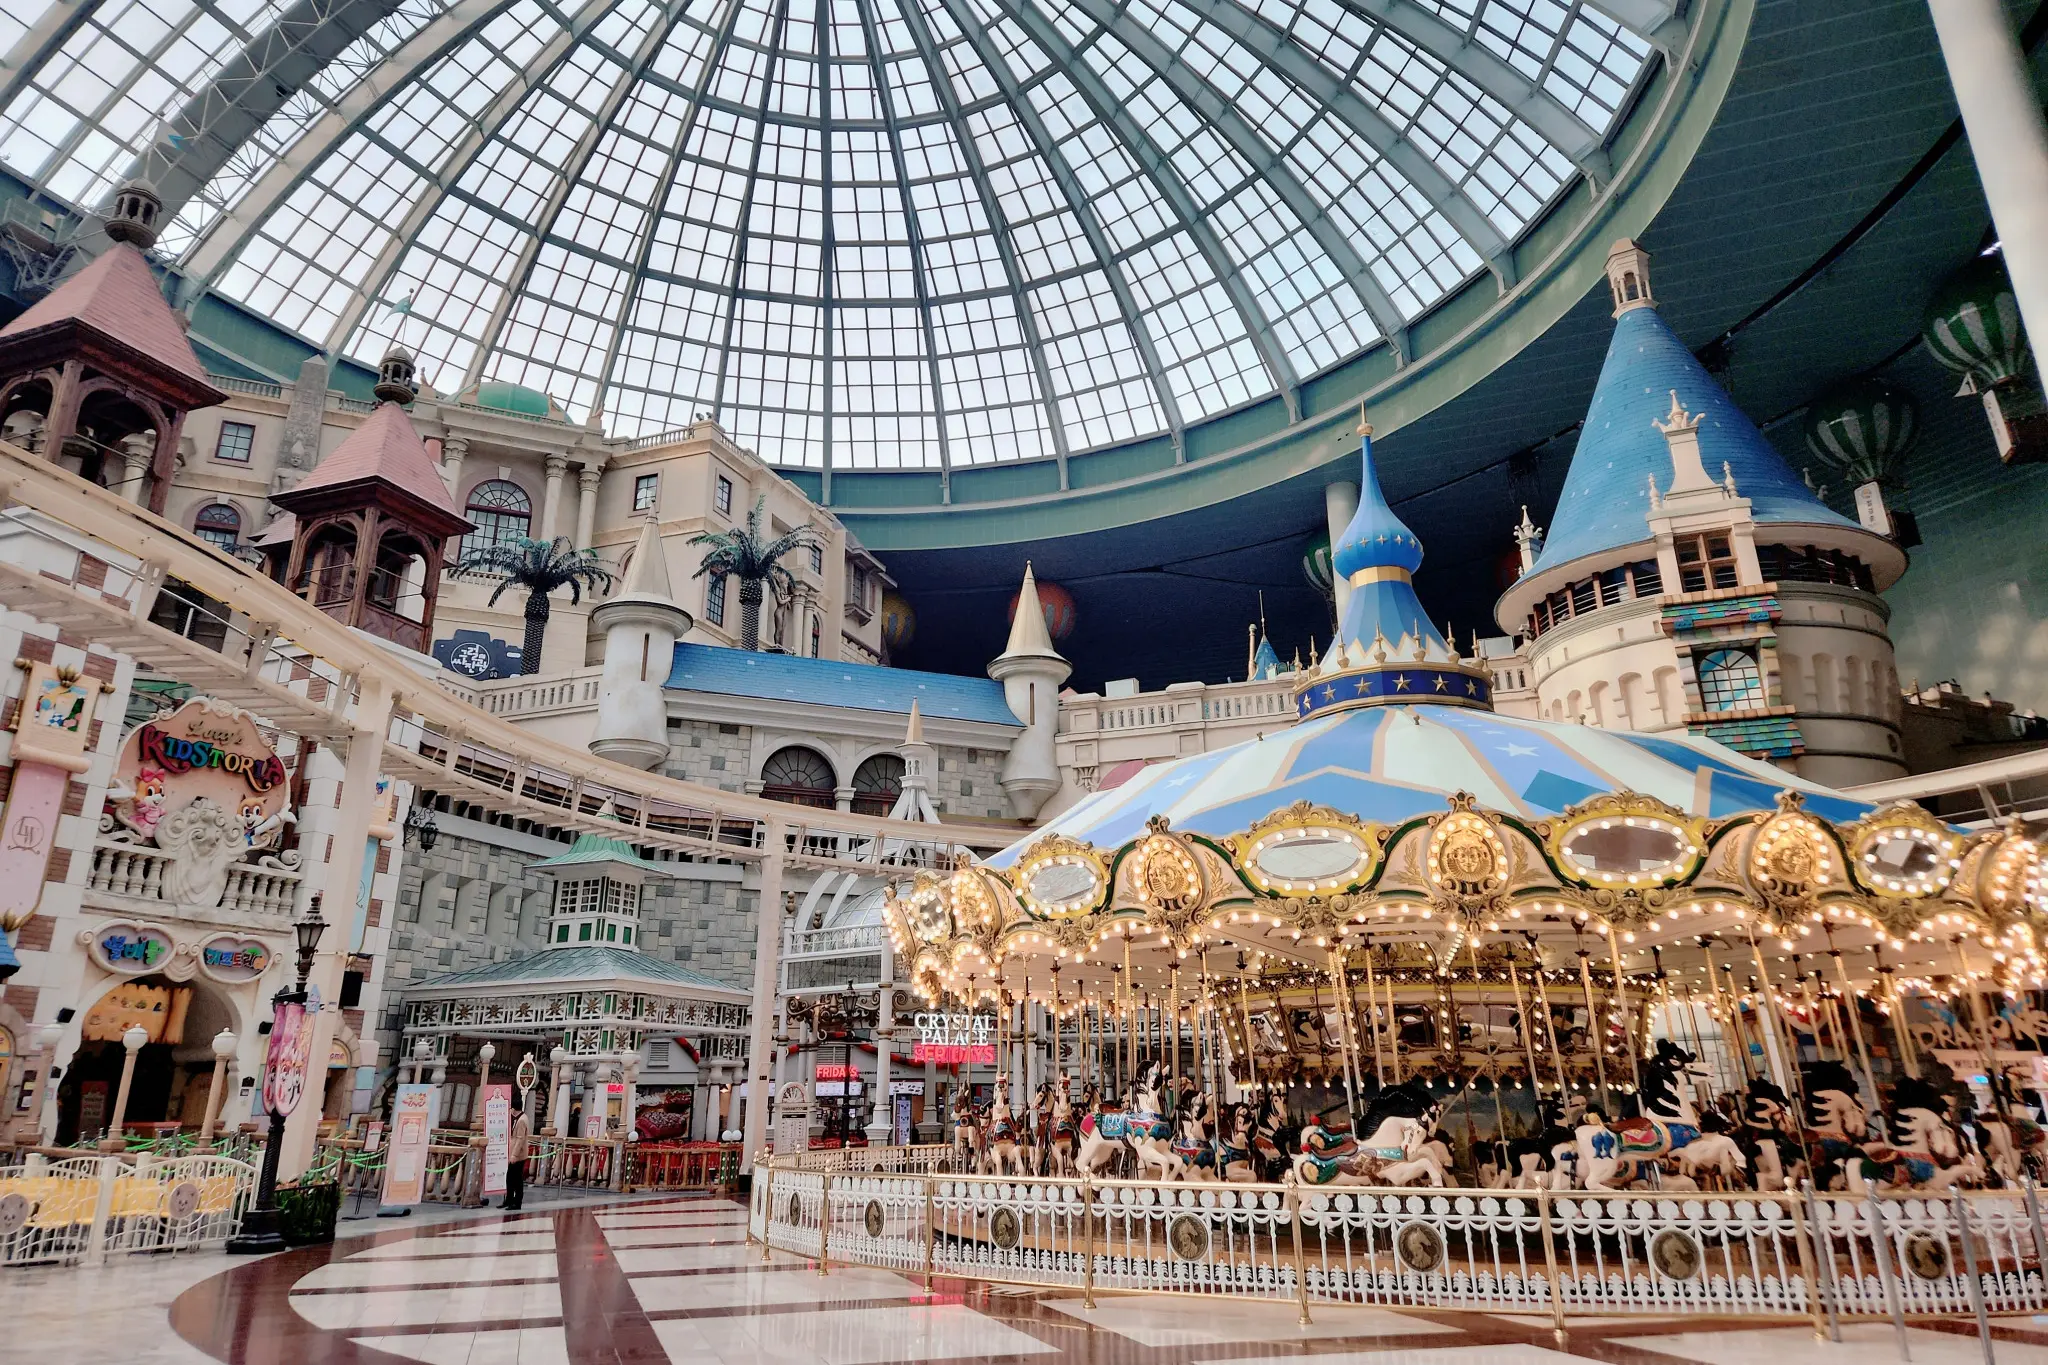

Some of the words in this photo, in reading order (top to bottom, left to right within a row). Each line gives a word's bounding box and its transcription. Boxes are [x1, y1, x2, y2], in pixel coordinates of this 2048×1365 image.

[139, 725, 285, 792] KIDSTORIA
[914, 1013, 994, 1031] CRYSTAL
[921, 1029, 989, 1046] PALACE
[924, 1045, 995, 1064] FRIDAYS
[816, 1066, 859, 1078] FRIDAS
